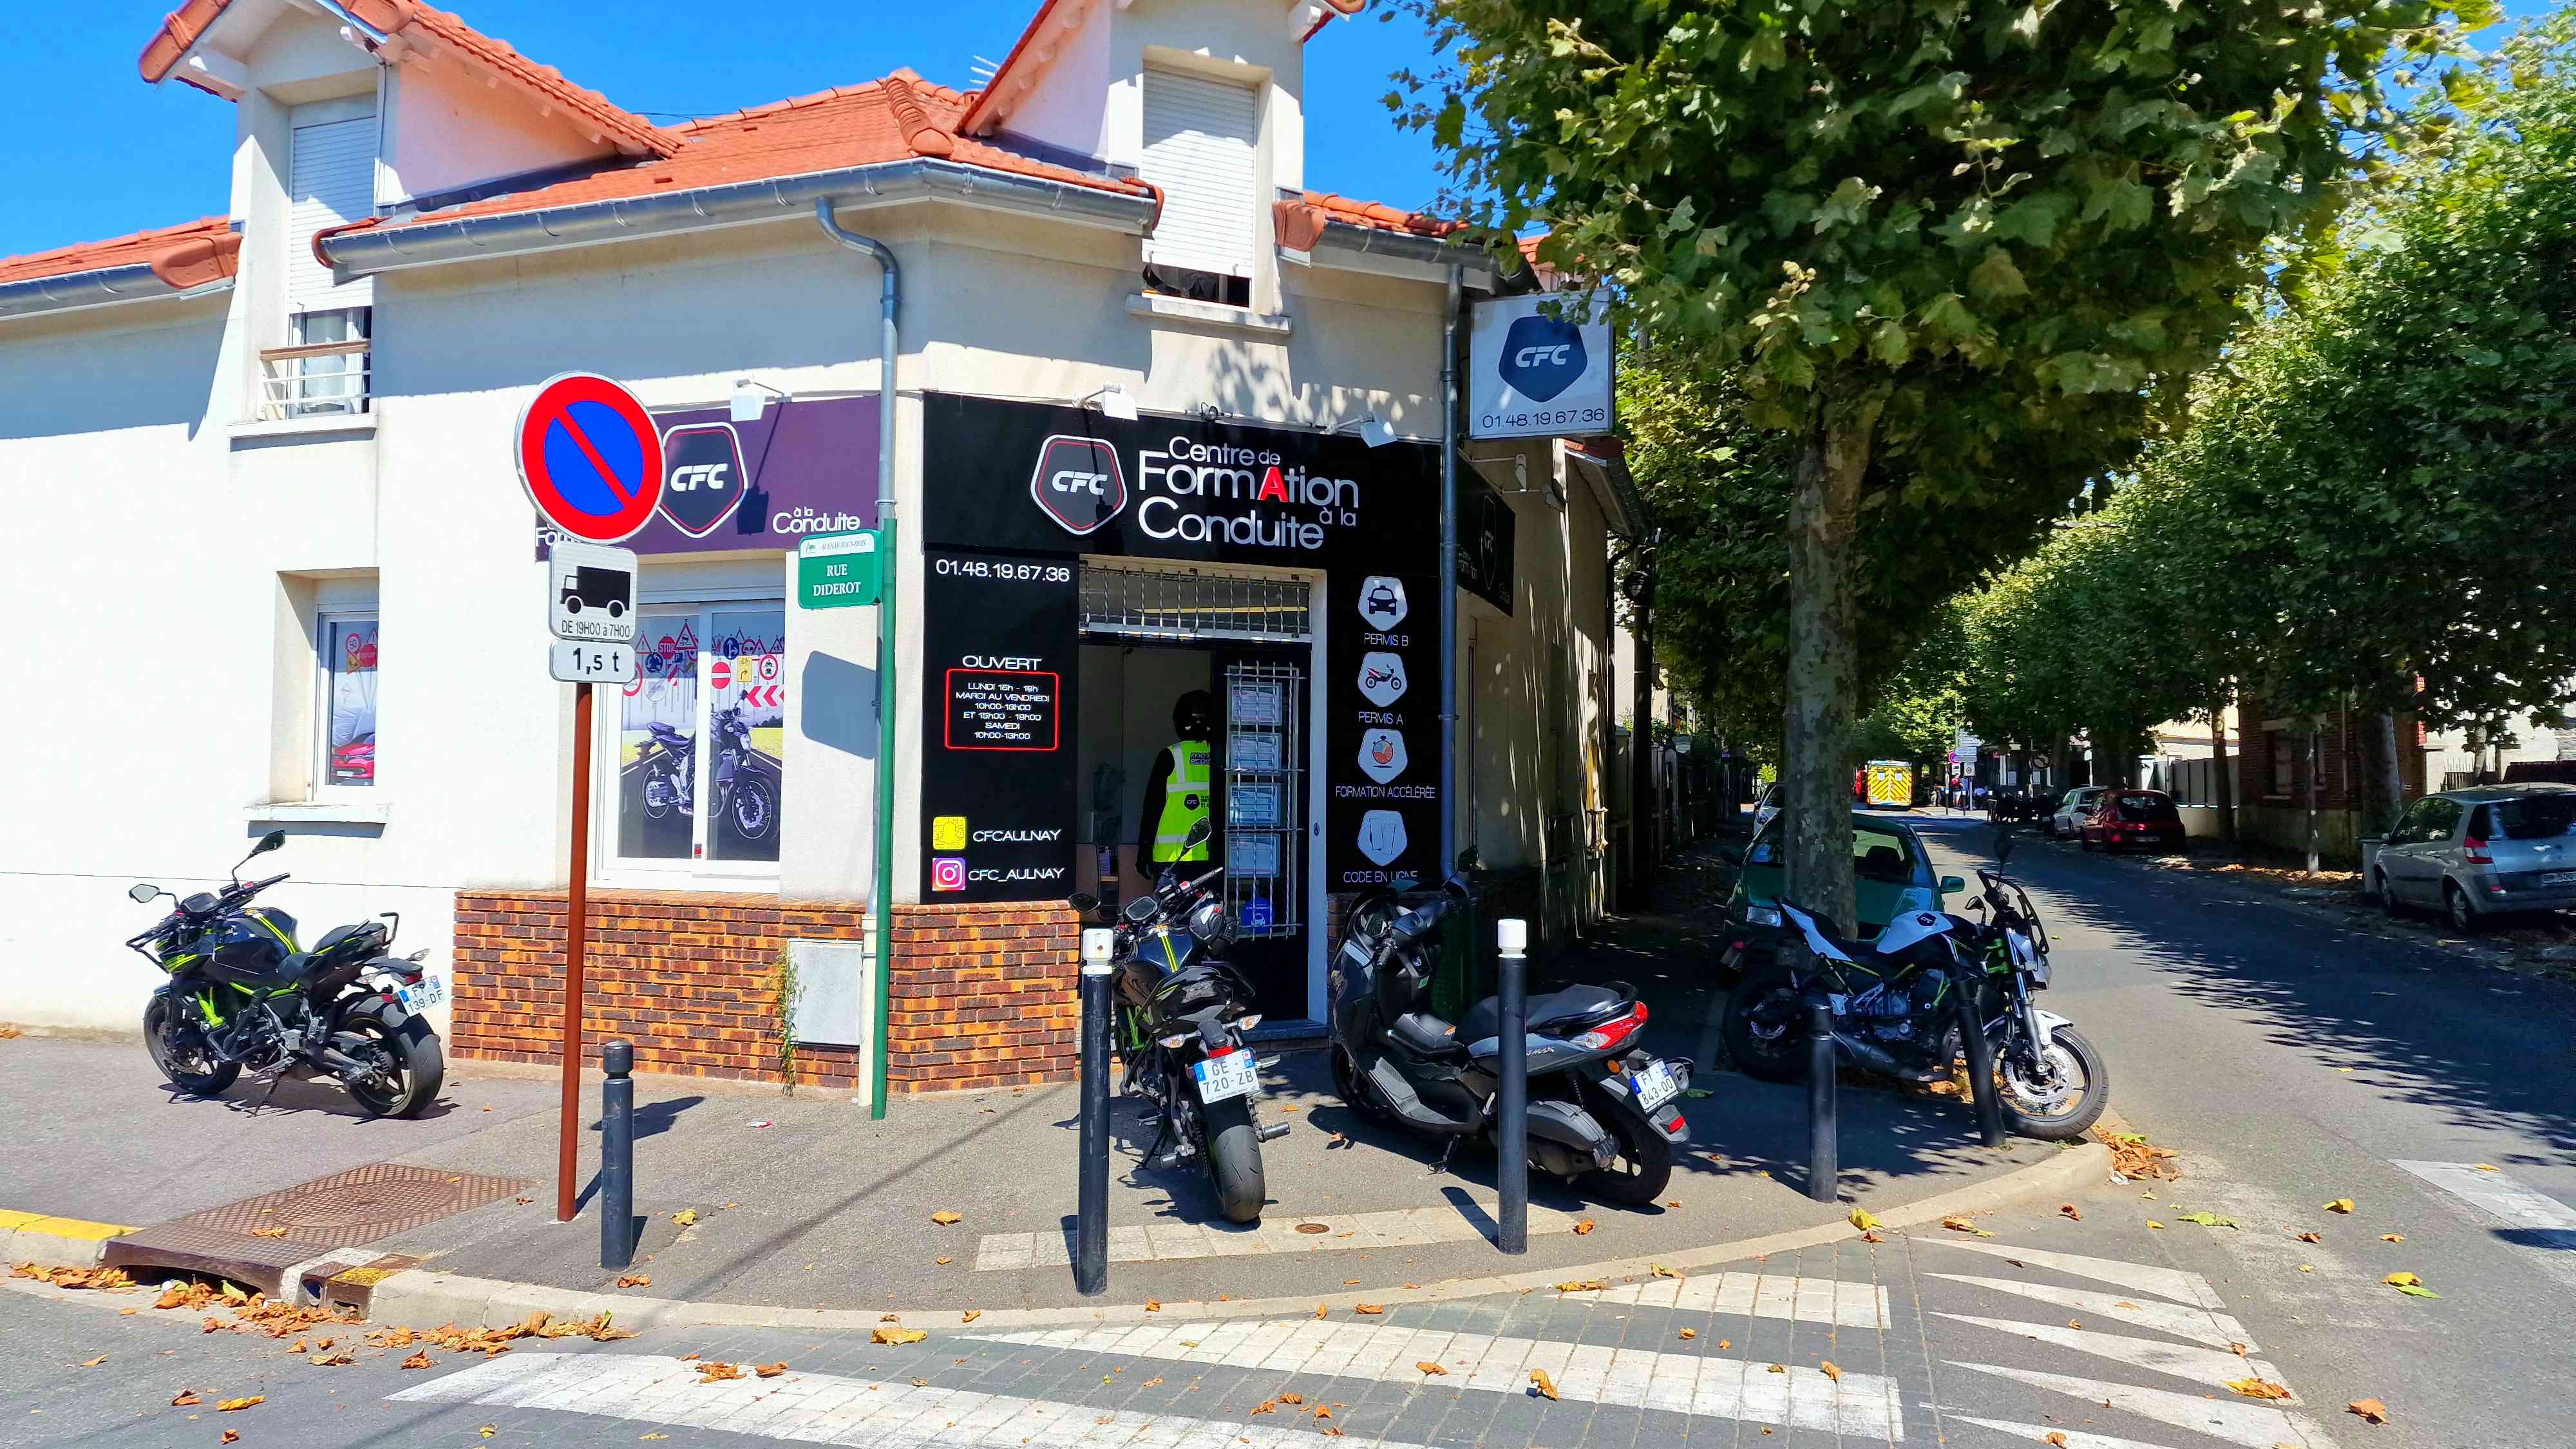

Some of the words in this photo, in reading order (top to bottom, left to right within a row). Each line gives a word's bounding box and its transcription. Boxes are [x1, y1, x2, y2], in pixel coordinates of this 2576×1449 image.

[1515, 344, 1571, 368] CFC
[1482, 408, 1605, 428] 01.48.19.67.36
[1169, 435, 1255, 466] Centre
[1258, 449, 1281, 465] de
[670, 463, 728, 491] CFC
[1052, 470, 1108, 495] CFC
[793, 507, 801, 517] à
[804, 506, 813, 516] la
[1320, 507, 1333, 524] à
[1341, 507, 1356, 526] la
[773, 511, 860, 534] Conduite
[1138, 495, 1324, 549] Conduite
[826, 564, 848, 577] RUE
[936, 558, 1070, 582] 01.48.19.67.36
[813, 582, 862, 596] DIDEROT
[562, 620, 573, 633] DE
[576, 621, 601, 636] 19H00
[609, 624, 630, 638] 7H00
[1364, 632, 1399, 646] PERMIS
[1402, 635, 1408, 647] B
[573, 647, 603, 675] 1,5
[612, 650, 620, 672] t
[961, 655, 1042, 670] OUVERT
[1004, 694, 1050, 703] VENDREDI
[1358, 712, 1393, 724] PERMIS
[1396, 714, 1404, 725] A
[1336, 786, 1385, 798] FORMATION
[1387, 784, 1435, 798] ACCÉLÉRÉE
[972, 828, 1062, 842] CFCAULNAY
[968, 867, 1065, 882] CFC_AULNAY
[1343, 871, 1372, 883] CODE
[1375, 871, 1388, 882] EN
[1203, 1070, 1254, 1094] 720-ZB
